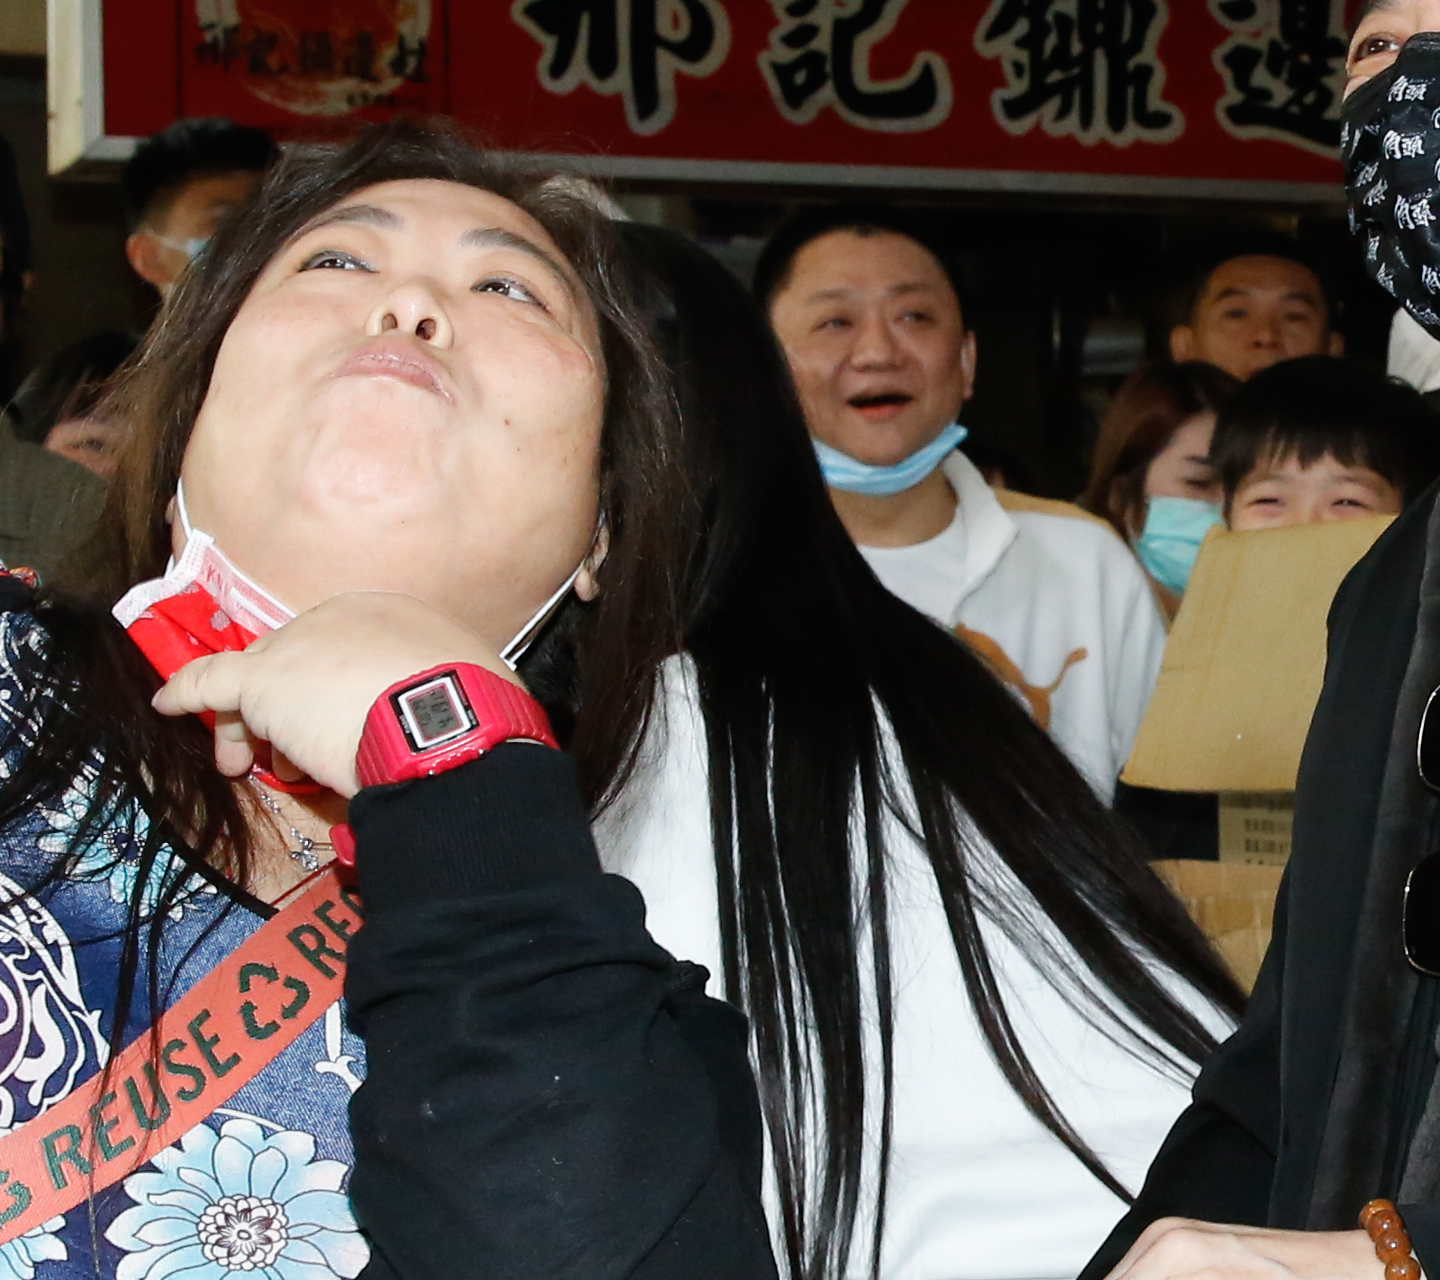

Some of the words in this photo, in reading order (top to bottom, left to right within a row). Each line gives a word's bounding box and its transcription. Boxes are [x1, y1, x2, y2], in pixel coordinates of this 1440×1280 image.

[1388, 75, 1427, 102] 角頭
[1383, 130, 1424, 159] 角頭
[1394, 195, 1436, 229] 角頭
[40, 1008, 242, 1192] REUSE
[286, 886, 364, 980] RE
